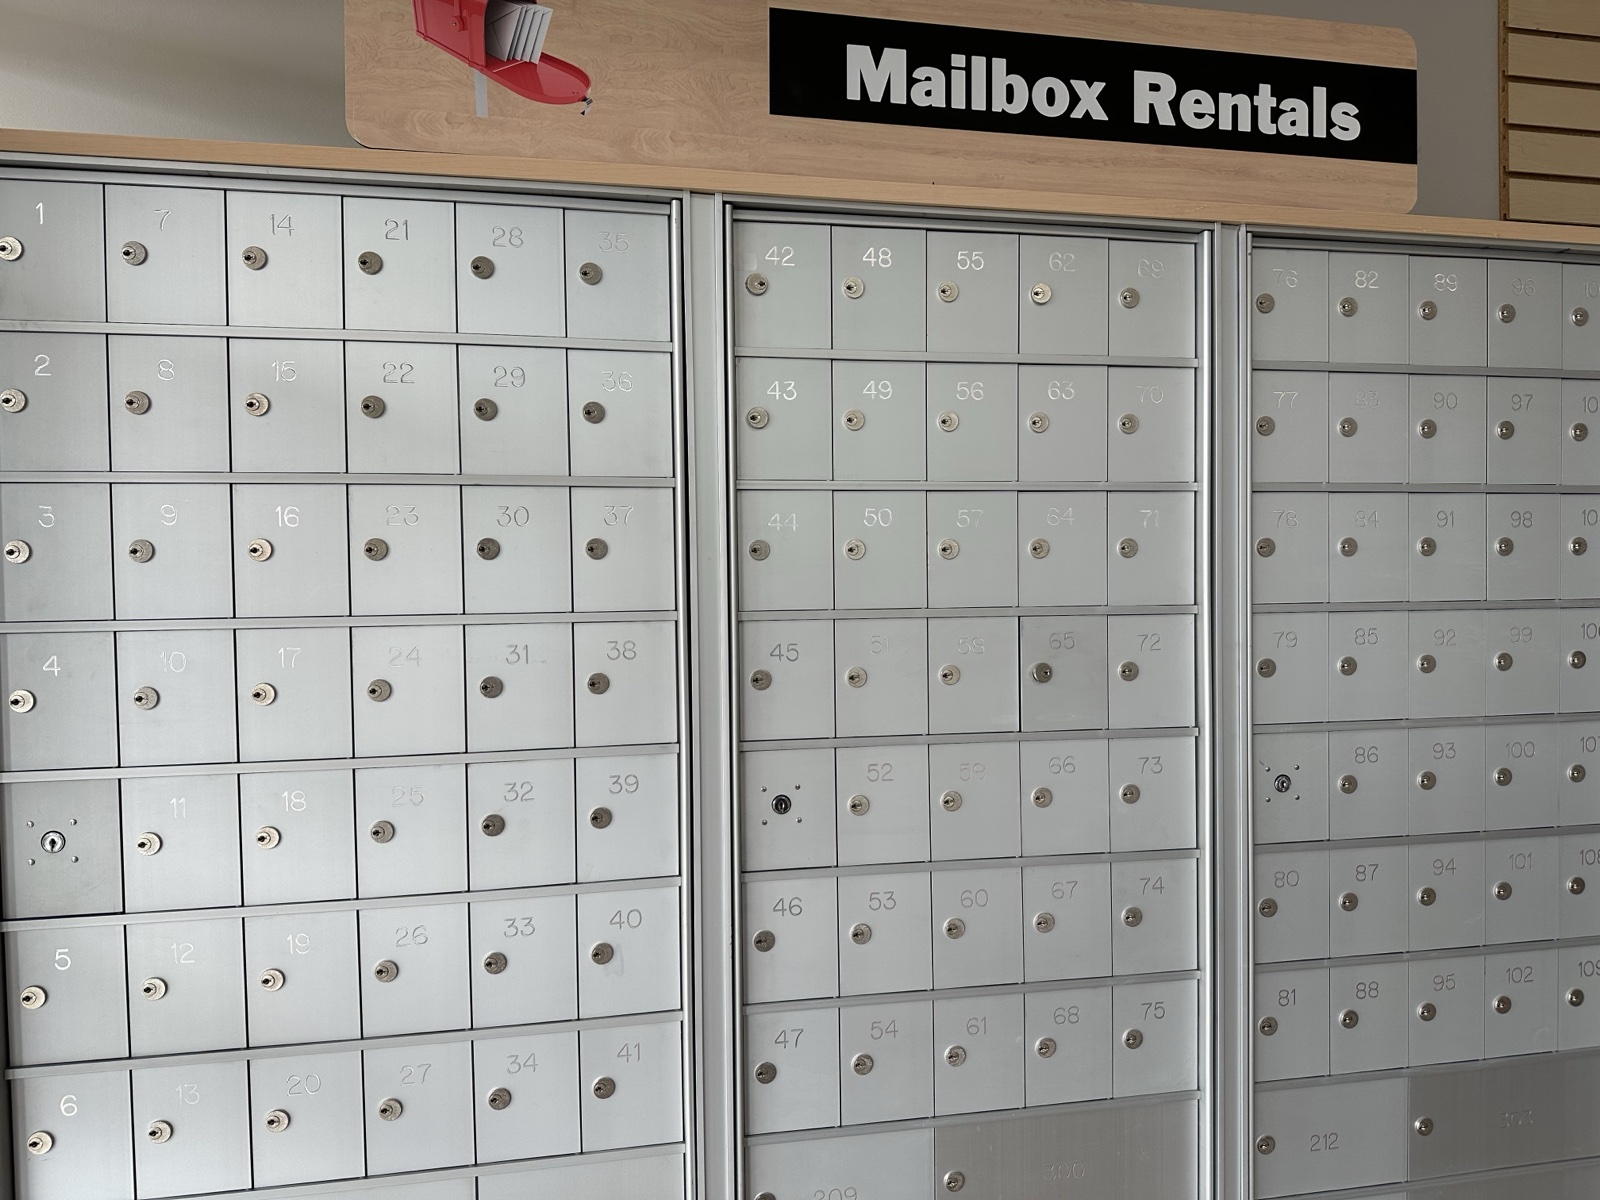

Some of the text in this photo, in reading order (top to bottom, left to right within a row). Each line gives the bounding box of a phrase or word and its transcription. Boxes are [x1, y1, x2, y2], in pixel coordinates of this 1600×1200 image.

[846, 44, 1362, 141] Mailbox Rentals
[36, 203, 44, 224] 1
[154, 209, 171, 231] 7
[269, 214, 294, 236] 14
[385, 219, 409, 240] 21
[492, 226, 525, 248] 28
[598, 232, 629, 252] 35
[765, 246, 795, 266] 42
[862, 248, 891, 267] 48
[957, 251, 984, 270] 55
[1048, 252, 1075, 272] 62
[1137, 259, 1163, 278] 69
[1273, 269, 1298, 287] 76
[1355, 270, 1379, 288] 82
[1434, 273, 1457, 292] 89
[1512, 279, 1535, 296] 96
[1584, 280, 1600, 297] 10
[34, 355, 51, 375] 2
[158, 359, 175, 380] 8
[272, 360, 296, 382] 15
[383, 362, 415, 384] 22
[494, 366, 525, 388] 29
[602, 371, 633, 392] 36
[767, 381, 796, 400] 43
[863, 381, 892, 399] 49
[956, 382, 983, 400] 56
[1047, 381, 1075, 400] 63
[1136, 385, 1164, 404] 70
[1274, 391, 1298, 409] 77
[1434, 393, 1458, 409] 90
[1512, 392, 1535, 413] 97
[39, 505, 55, 527] 3
[161, 504, 178, 526] 9
[276, 506, 299, 527] 16
[386, 505, 419, 526] 23
[497, 505, 530, 527] 30
[604, 506, 633, 526] 37
[767, 513, 798, 531] 44
[864, 508, 892, 526] 50
[956, 510, 983, 527] 57
[1047, 508, 1074, 526] 64
[1140, 509, 1160, 528] 71
[1273, 510, 1298, 528] 78
[1356, 510, 1378, 528] 84
[1436, 511, 1454, 527] 91
[1511, 510, 1534, 529] 98
[1049, 632, 1076, 650] 65
[1273, 631, 1298, 648] 79
[1354, 627, 1379, 645] 85
[1432, 627, 1457, 647] 92
[1510, 627, 1532, 643] 99
[1581, 623, 1600, 640] 10
[607, 640, 637, 660] 38
[958, 636, 985, 655] 58
[1137, 633, 1162, 651] 72
[160, 651, 186, 672] 10
[277, 647, 302, 669] 17
[389, 647, 420, 667] 24
[506, 644, 528, 664] 31
[770, 643, 799, 662] 45
[43, 656, 60, 676] 4
[1432, 741, 1457, 759] 93
[1506, 740, 1536, 760] 100
[1580, 736, 1600, 752] 10
[1354, 745, 1379, 764] 86
[867, 762, 893, 782] 52
[1049, 756, 1077, 775] 66
[1138, 755, 1163, 775] 73
[504, 781, 534, 802] 32
[609, 774, 639, 794] 39
[282, 791, 306, 811] 18
[393, 786, 424, 807] 25
[170, 798, 186, 818] 11
[1432, 858, 1456, 876] 94
[1509, 854, 1533, 870] 101
[1273, 870, 1300, 888] 80
[1355, 863, 1378, 882] 87
[1052, 881, 1078, 899] 67
[1139, 877, 1164, 895] 74
[773, 897, 802, 916] 46
[869, 890, 896, 910] 53
[960, 889, 989, 908] 60
[504, 917, 535, 937] 33
[610, 909, 642, 929] 40
[286, 933, 311, 955] 19
[396, 924, 429, 949] 26
[55, 948, 72, 970] 5
[170, 942, 196, 966] 12
[1432, 973, 1457, 992] 95
[1506, 965, 1534, 984] 102
[1279, 989, 1295, 1006] 81
[1355, 981, 1380, 999] 88
[1054, 1006, 1080, 1025] 68
[1141, 1002, 1166, 1020] 75
[871, 1020, 898, 1040] 54
[967, 1017, 987, 1037] 61
[775, 1028, 804, 1048] 47
[616, 1042, 641, 1063] 41
[505, 1052, 538, 1074] 34
[400, 1063, 432, 1086] 27
[176, 1084, 200, 1104] 13
[287, 1074, 321, 1096] 20
[60, 1095, 77, 1116] 6
[1310, 1132, 1339, 1152] 212
[1043, 1160, 1085, 1181] 300
